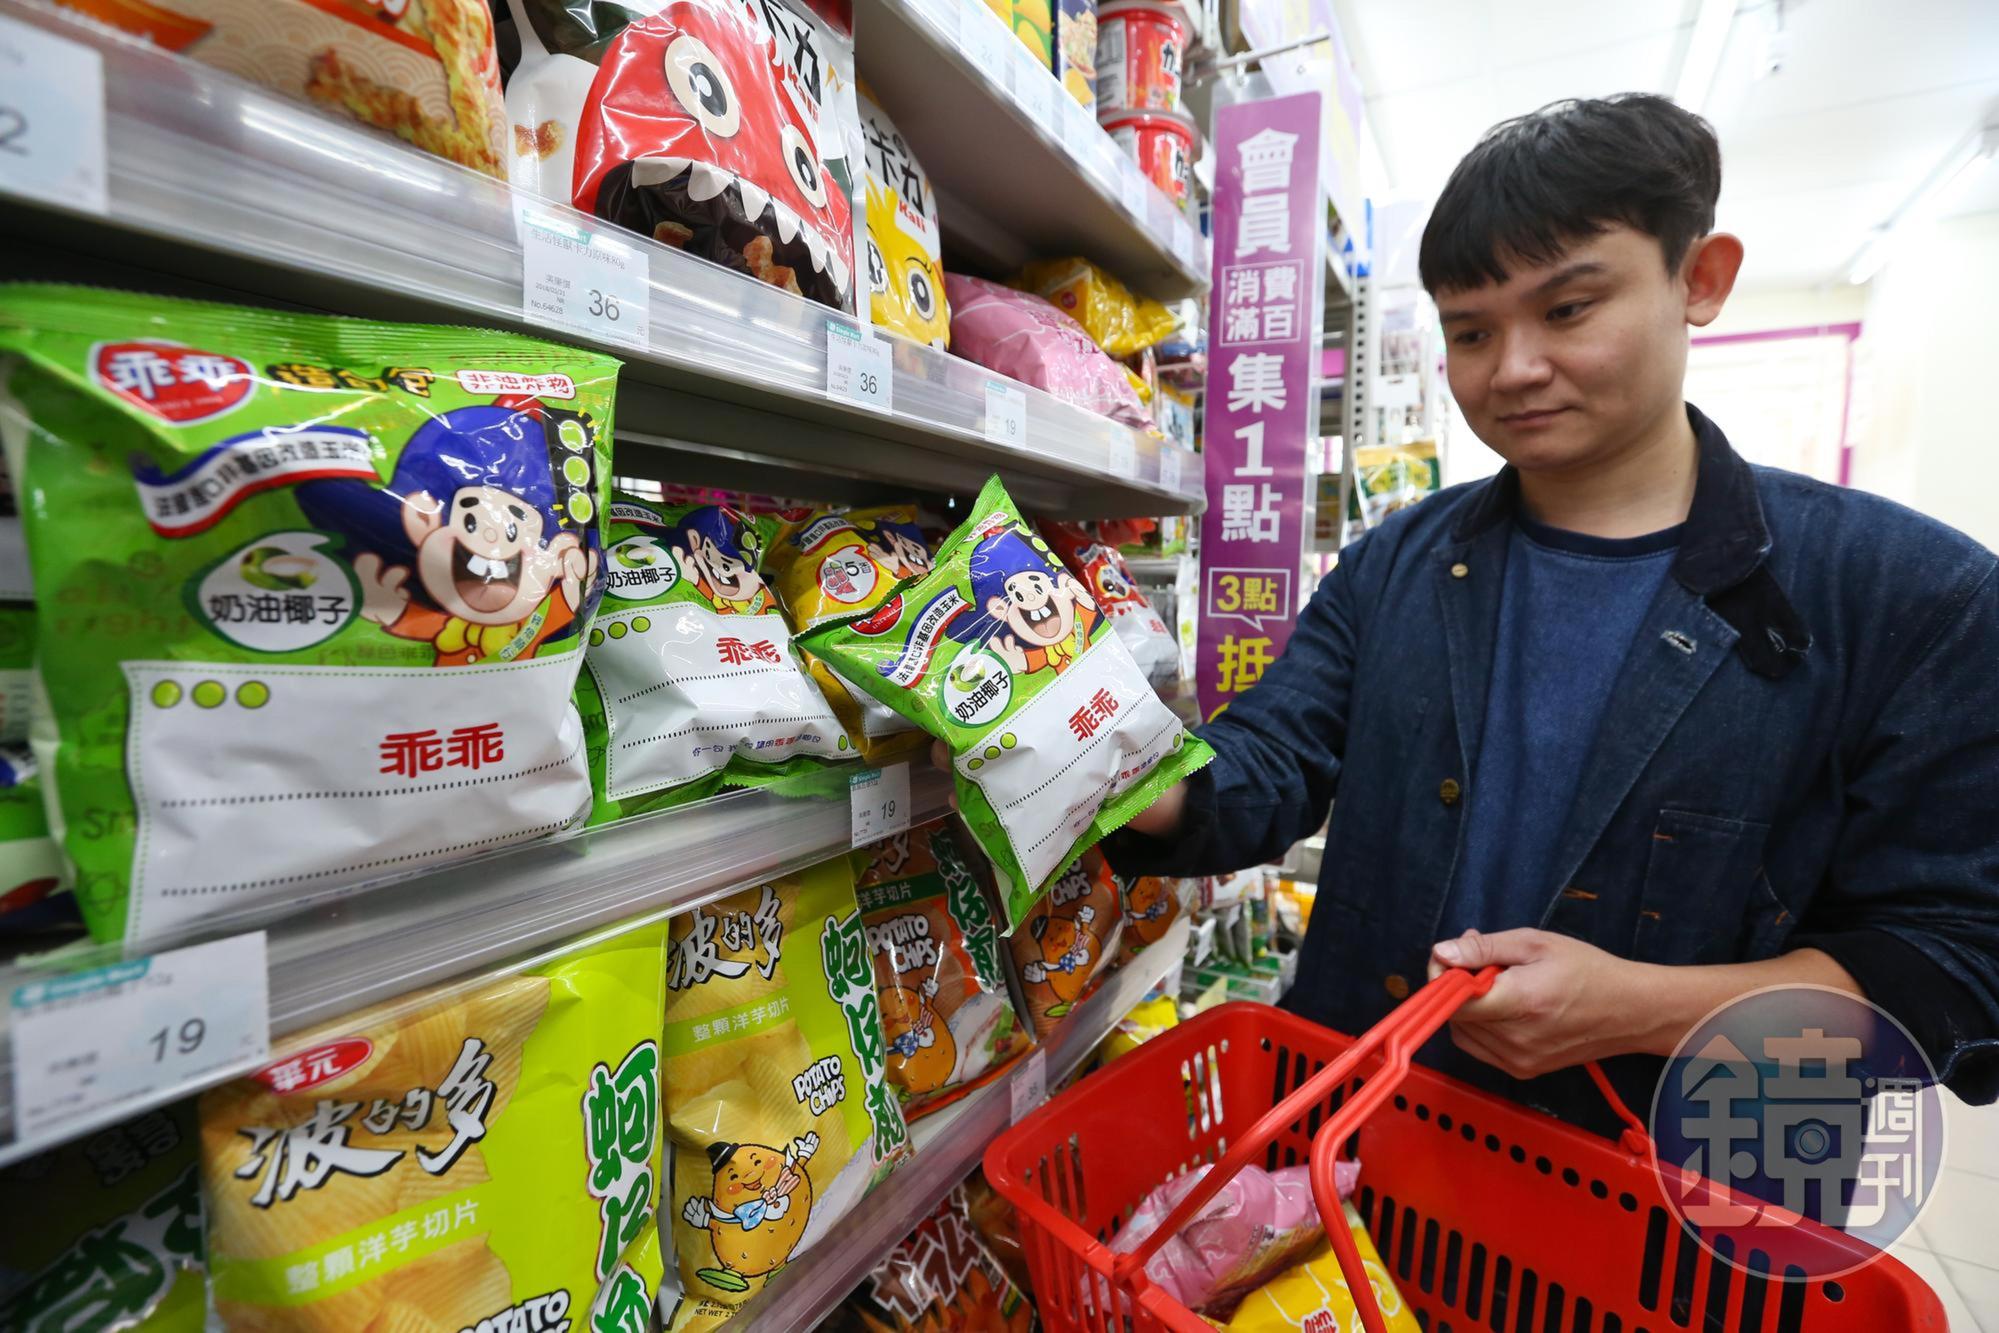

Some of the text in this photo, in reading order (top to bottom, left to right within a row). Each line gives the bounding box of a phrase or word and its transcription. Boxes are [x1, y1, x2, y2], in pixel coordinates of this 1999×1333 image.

[1235, 127, 1299, 259] 會員
[588, 289, 620, 321] 36
[1227, 264, 1298, 307] 消費
[1225, 307, 1296, 343] 滿百
[107, 350, 237, 400] 乖乖
[860, 372, 878, 394] 36
[1004, 418, 1017, 435] 19
[1221, 353, 1288, 543] 集1點
[606, 567, 676, 588] 奶油椰子
[1216, 574, 1278, 612] 3點
[208, 592, 350, 627] 奶油椰子
[716, 636, 781, 666] 乖乖
[1216, 634, 1275, 693] 抵
[955, 671, 1009, 722] 奶油椰子
[1068, 687, 1119, 742] 乖乖
[378, 722, 505, 778] 乖乖
[881, 799, 896, 820] 19
[865, 915, 930, 956] POTATO
[893, 937, 939, 974] CHIPS
[151, 1017, 206, 1063] 19
[691, 996, 790, 1043] 整顆洋芋切片
[270, 1048, 342, 1093] 華元
[792, 1055, 843, 1105] POTATO
[808, 1073, 846, 1117] CHIPS
[235, 1037, 498, 1208] 波的多
[286, 1198, 480, 1296] 整顆洋芋切片
